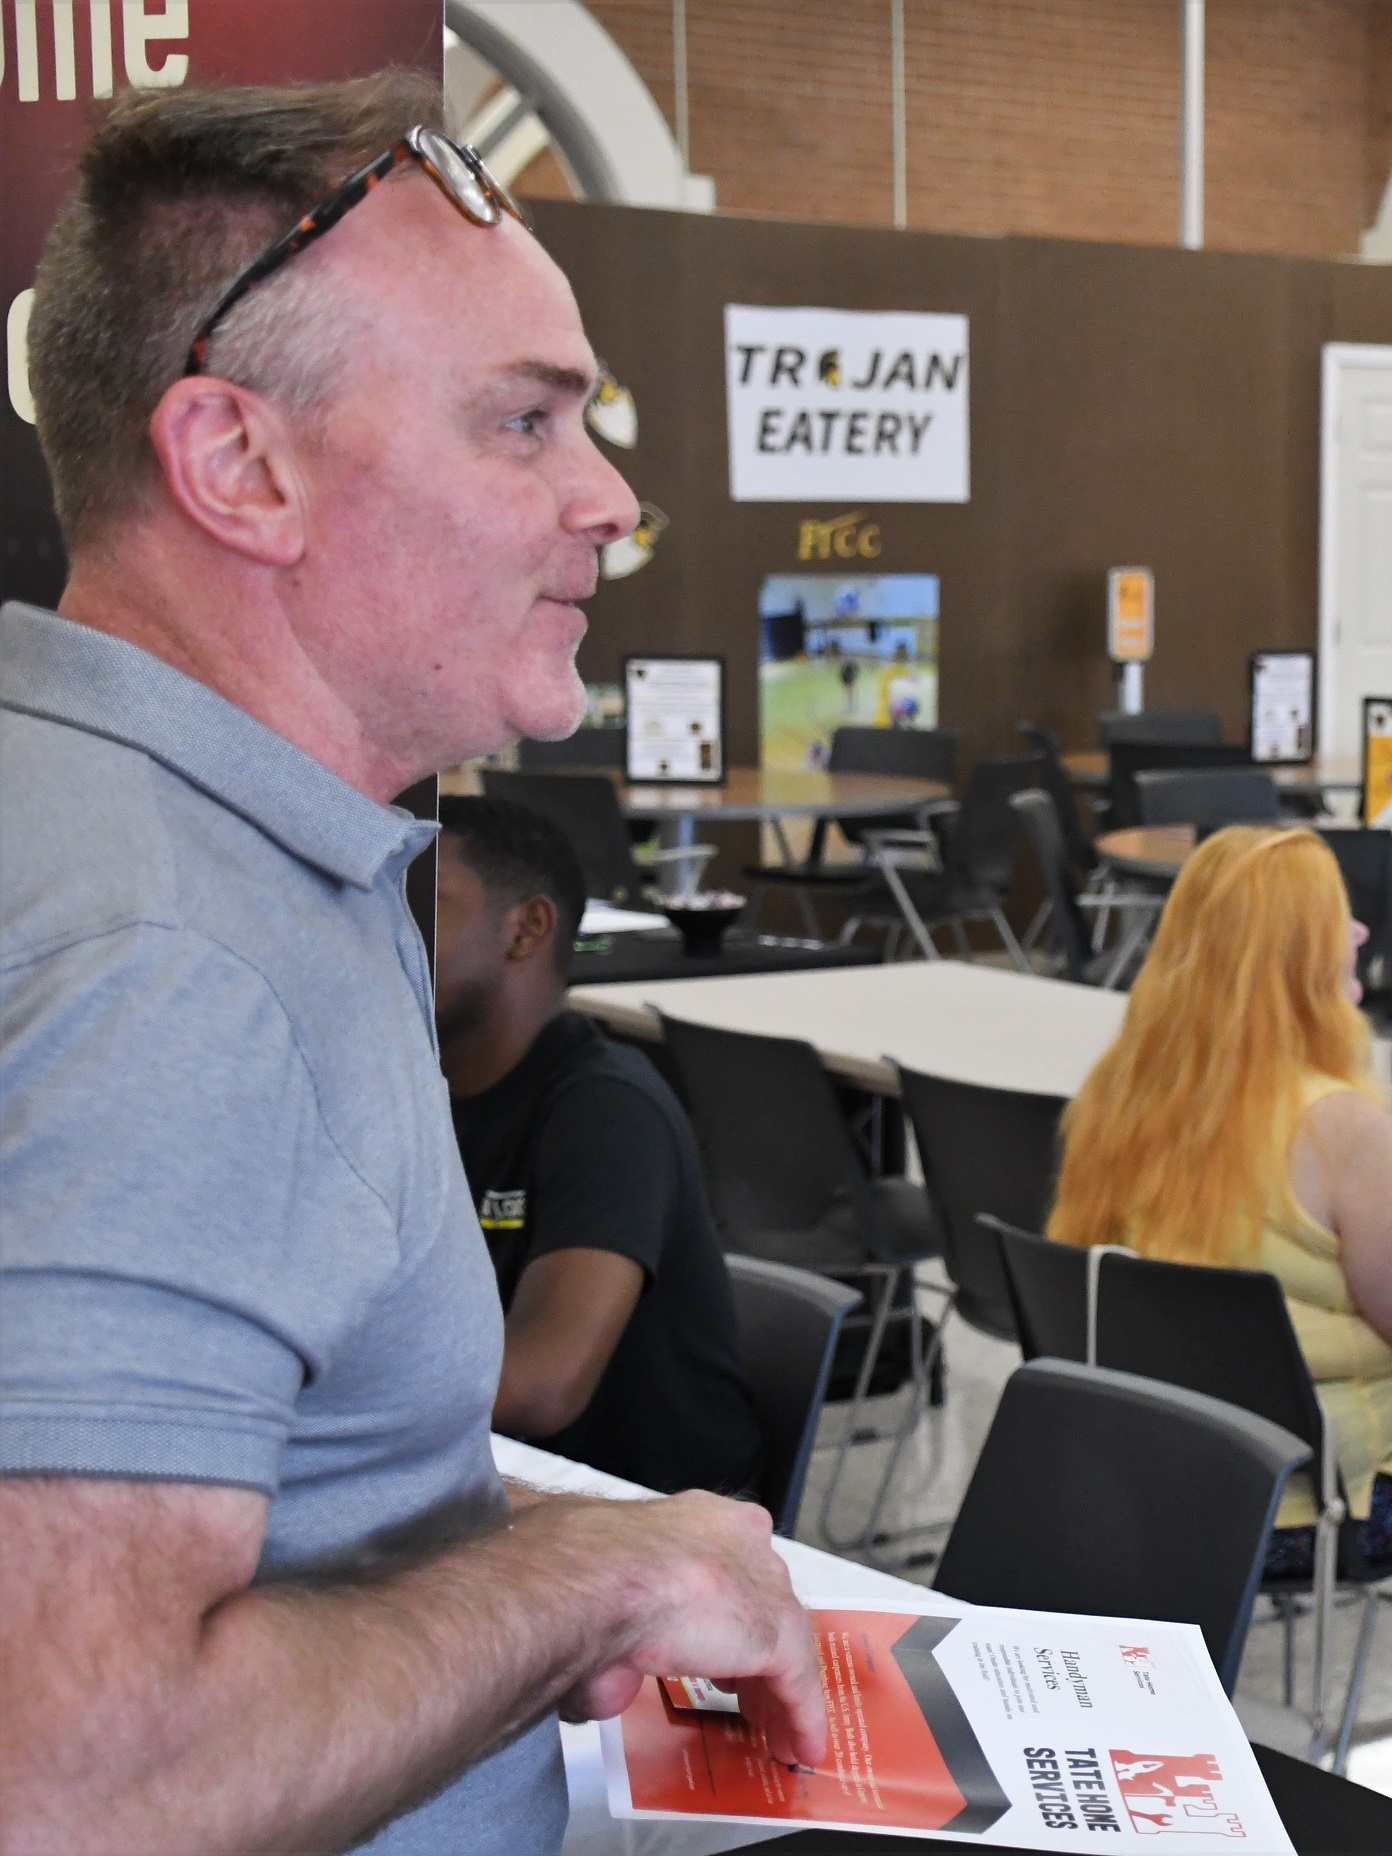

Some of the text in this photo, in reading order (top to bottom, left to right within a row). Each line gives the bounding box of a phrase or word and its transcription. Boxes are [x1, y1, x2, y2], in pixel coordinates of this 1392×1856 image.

[757, 408, 934, 456] EATERY
[1034, 1647, 1060, 1690] Services
[1060, 1650, 1093, 1708] Handyman
[1023, 1746, 1079, 1830] SERVICES
[1064, 1747, 1122, 1833] TATE HOME
